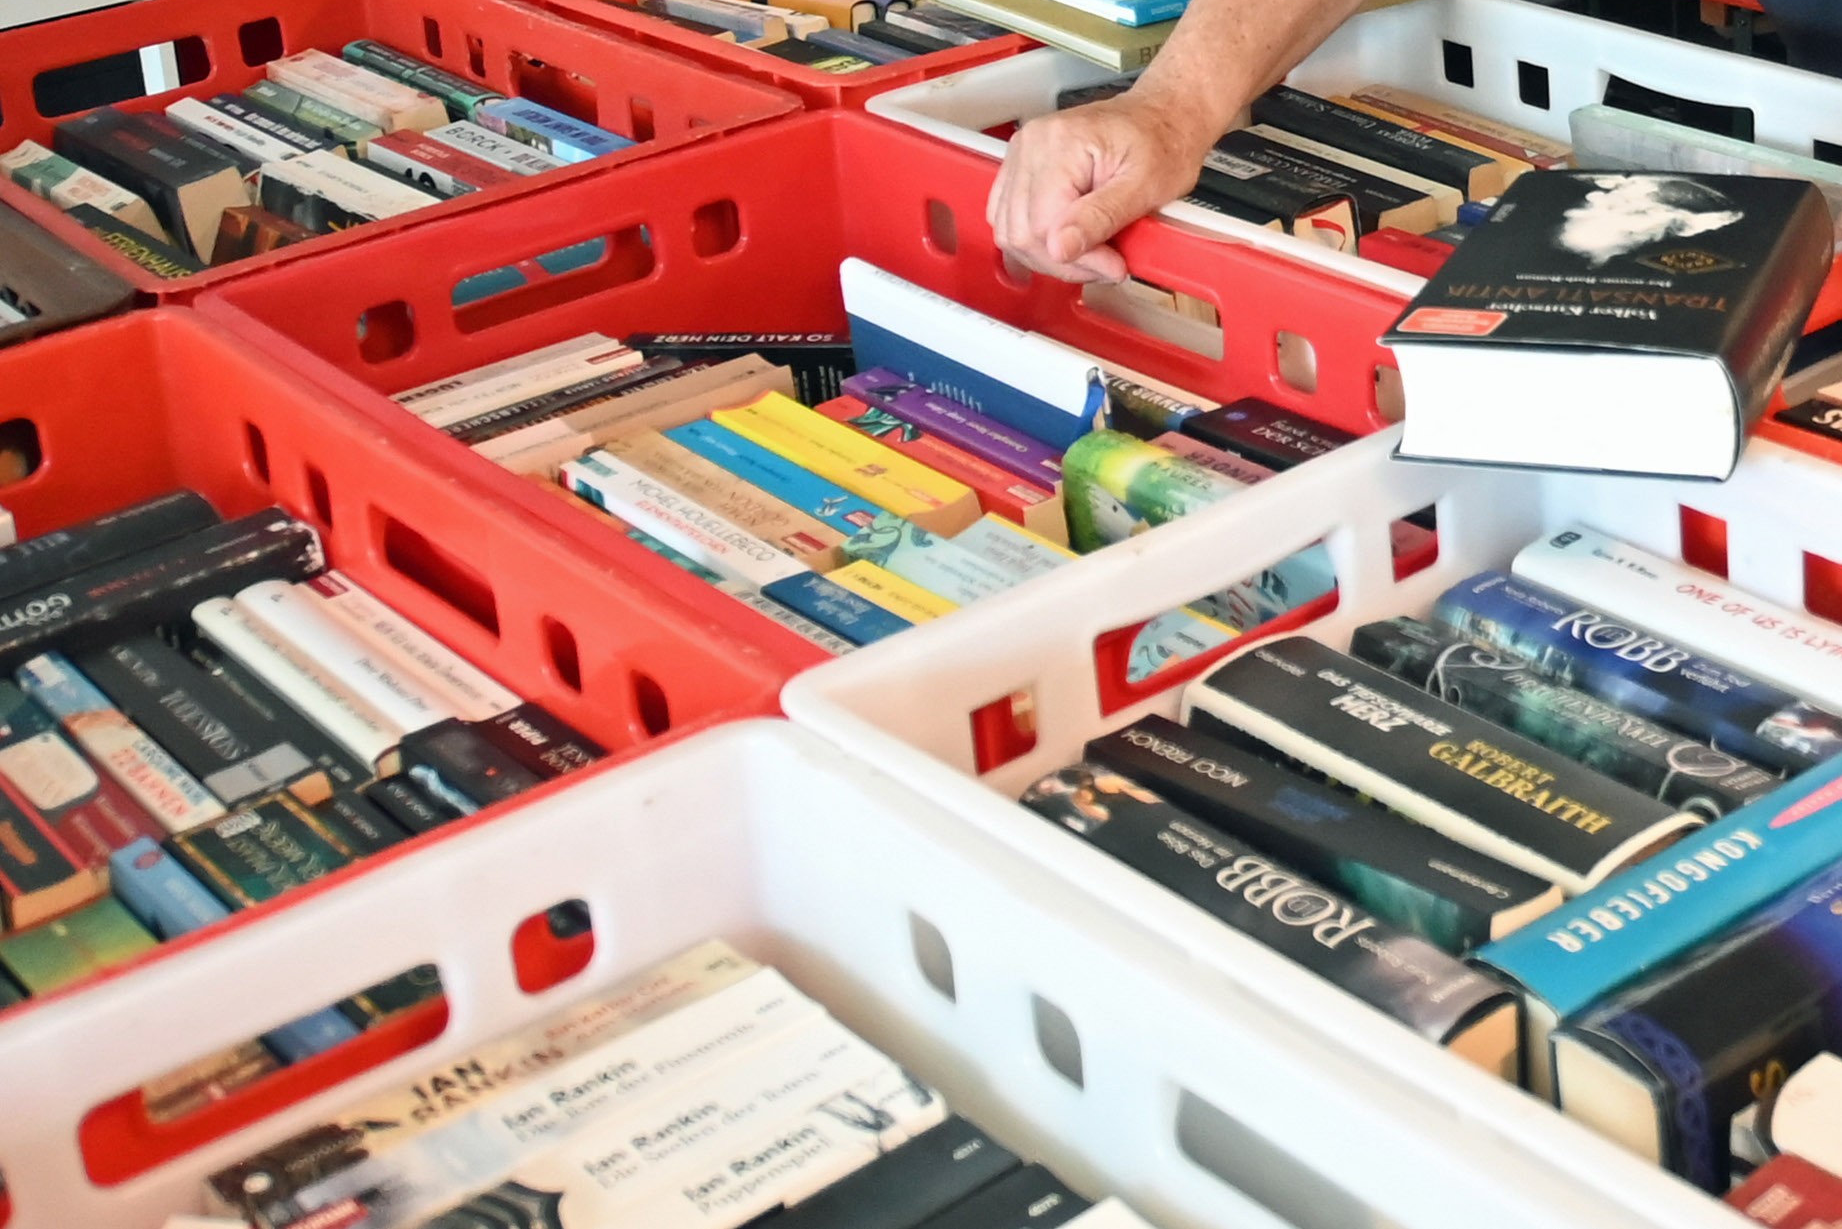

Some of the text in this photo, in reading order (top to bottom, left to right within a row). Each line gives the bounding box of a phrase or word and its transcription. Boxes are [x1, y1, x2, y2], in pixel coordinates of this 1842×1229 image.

[653, 333, 834, 343] SO KALT DEIN HERZ
[630, 478, 677, 512] MICHEL
[677, 499, 776, 563] HOUELLEBECQ
[1553, 609, 1691, 675] ROBB
[1676, 582, 1716, 607] ONE
[1721, 596, 1752, 617] OF
[1752, 610, 1779, 632] US
[1779, 621, 1800, 641] IS
[1316, 668, 1350, 688] DAS
[1329, 694, 1409, 733] HERZ
[1120, 728, 1252, 789] NICCI FRENCH
[1428, 740, 1613, 835] GALBRAITH
[1465, 738, 1557, 784] ROBERT
[1216, 854, 1377, 950] ROBB
[1546, 828, 1765, 954] KONGOFIEBER
[503, 1059, 639, 1130] Ian Rankin
[583, 1101, 720, 1176] Ian Rankin
[682, 1124, 819, 1203] Ian Rankin
